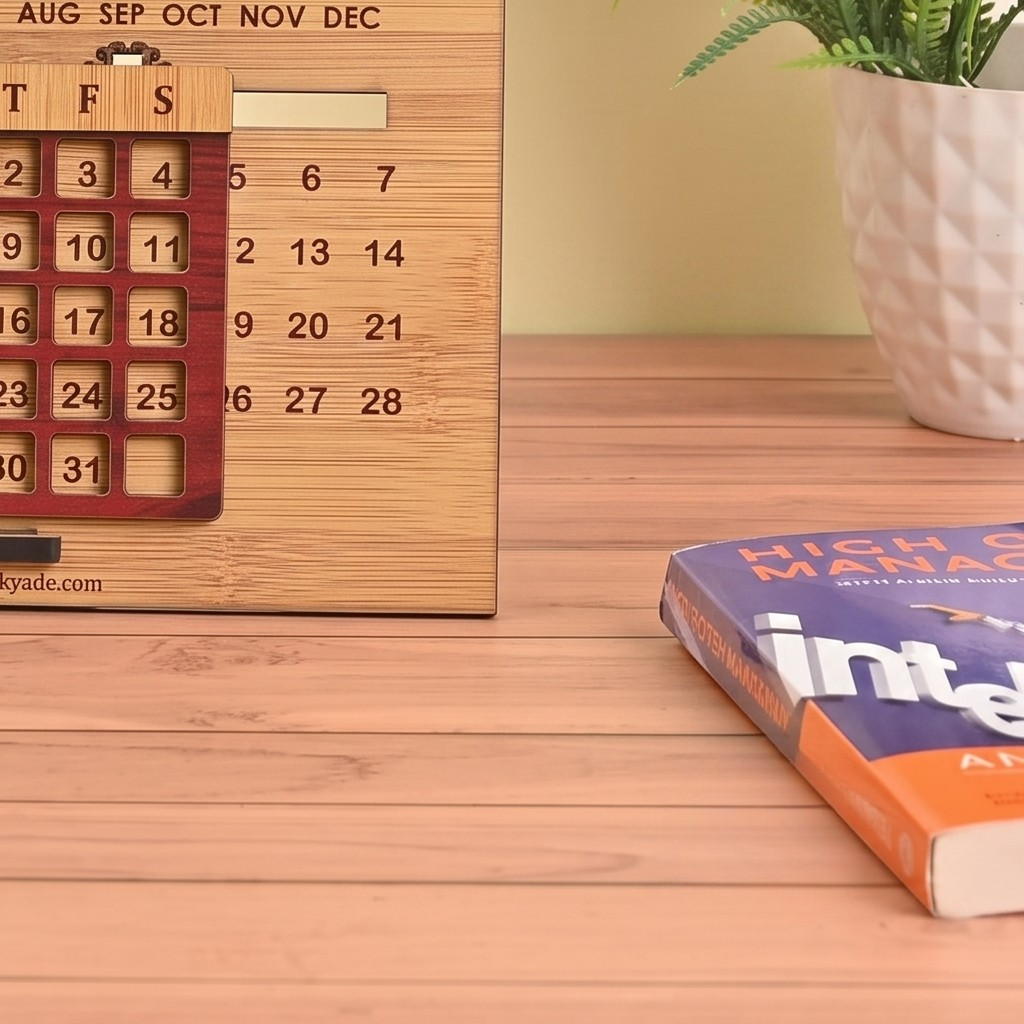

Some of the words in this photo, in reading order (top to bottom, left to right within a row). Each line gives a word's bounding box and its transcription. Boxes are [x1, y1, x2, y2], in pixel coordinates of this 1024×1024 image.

[17, 2, 81, 25] AUG
[99, 3, 145, 25] SEP
[162, 4, 222, 27] OCT
[240, 5, 306, 28] NOV
[324, 6, 381, 29] DEC
[2, 83, 27, 113] T
[78, 84, 99, 114] F
[153, 85, 173, 115] S
[4, 159, 23, 186] 2
[78, 160, 97, 188] 3
[152, 162, 172, 189] 4
[229, 163, 247, 190] 5
[302, 164, 321, 192] 6
[377, 165, 396, 193] 7
[2, 232, 22, 260] 9
[66, 234, 107, 261] 10
[144, 235, 180, 263] 11
[290, 238, 330, 266] 13
[364, 239, 405, 267] 14
[65, 308, 105, 335] 17
[139, 309, 179, 336] 18
[288, 312, 328, 340] 20
[365, 313, 401, 341] 21
[62, 382, 103, 409] 24
[137, 383, 177, 411] 25
[226, 385, 252, 413] 6
[285, 386, 328, 414] 27
[361, 387, 402, 416] 28
[62, 456, 100, 483] 31
[737, 536, 948, 562] HIGH
